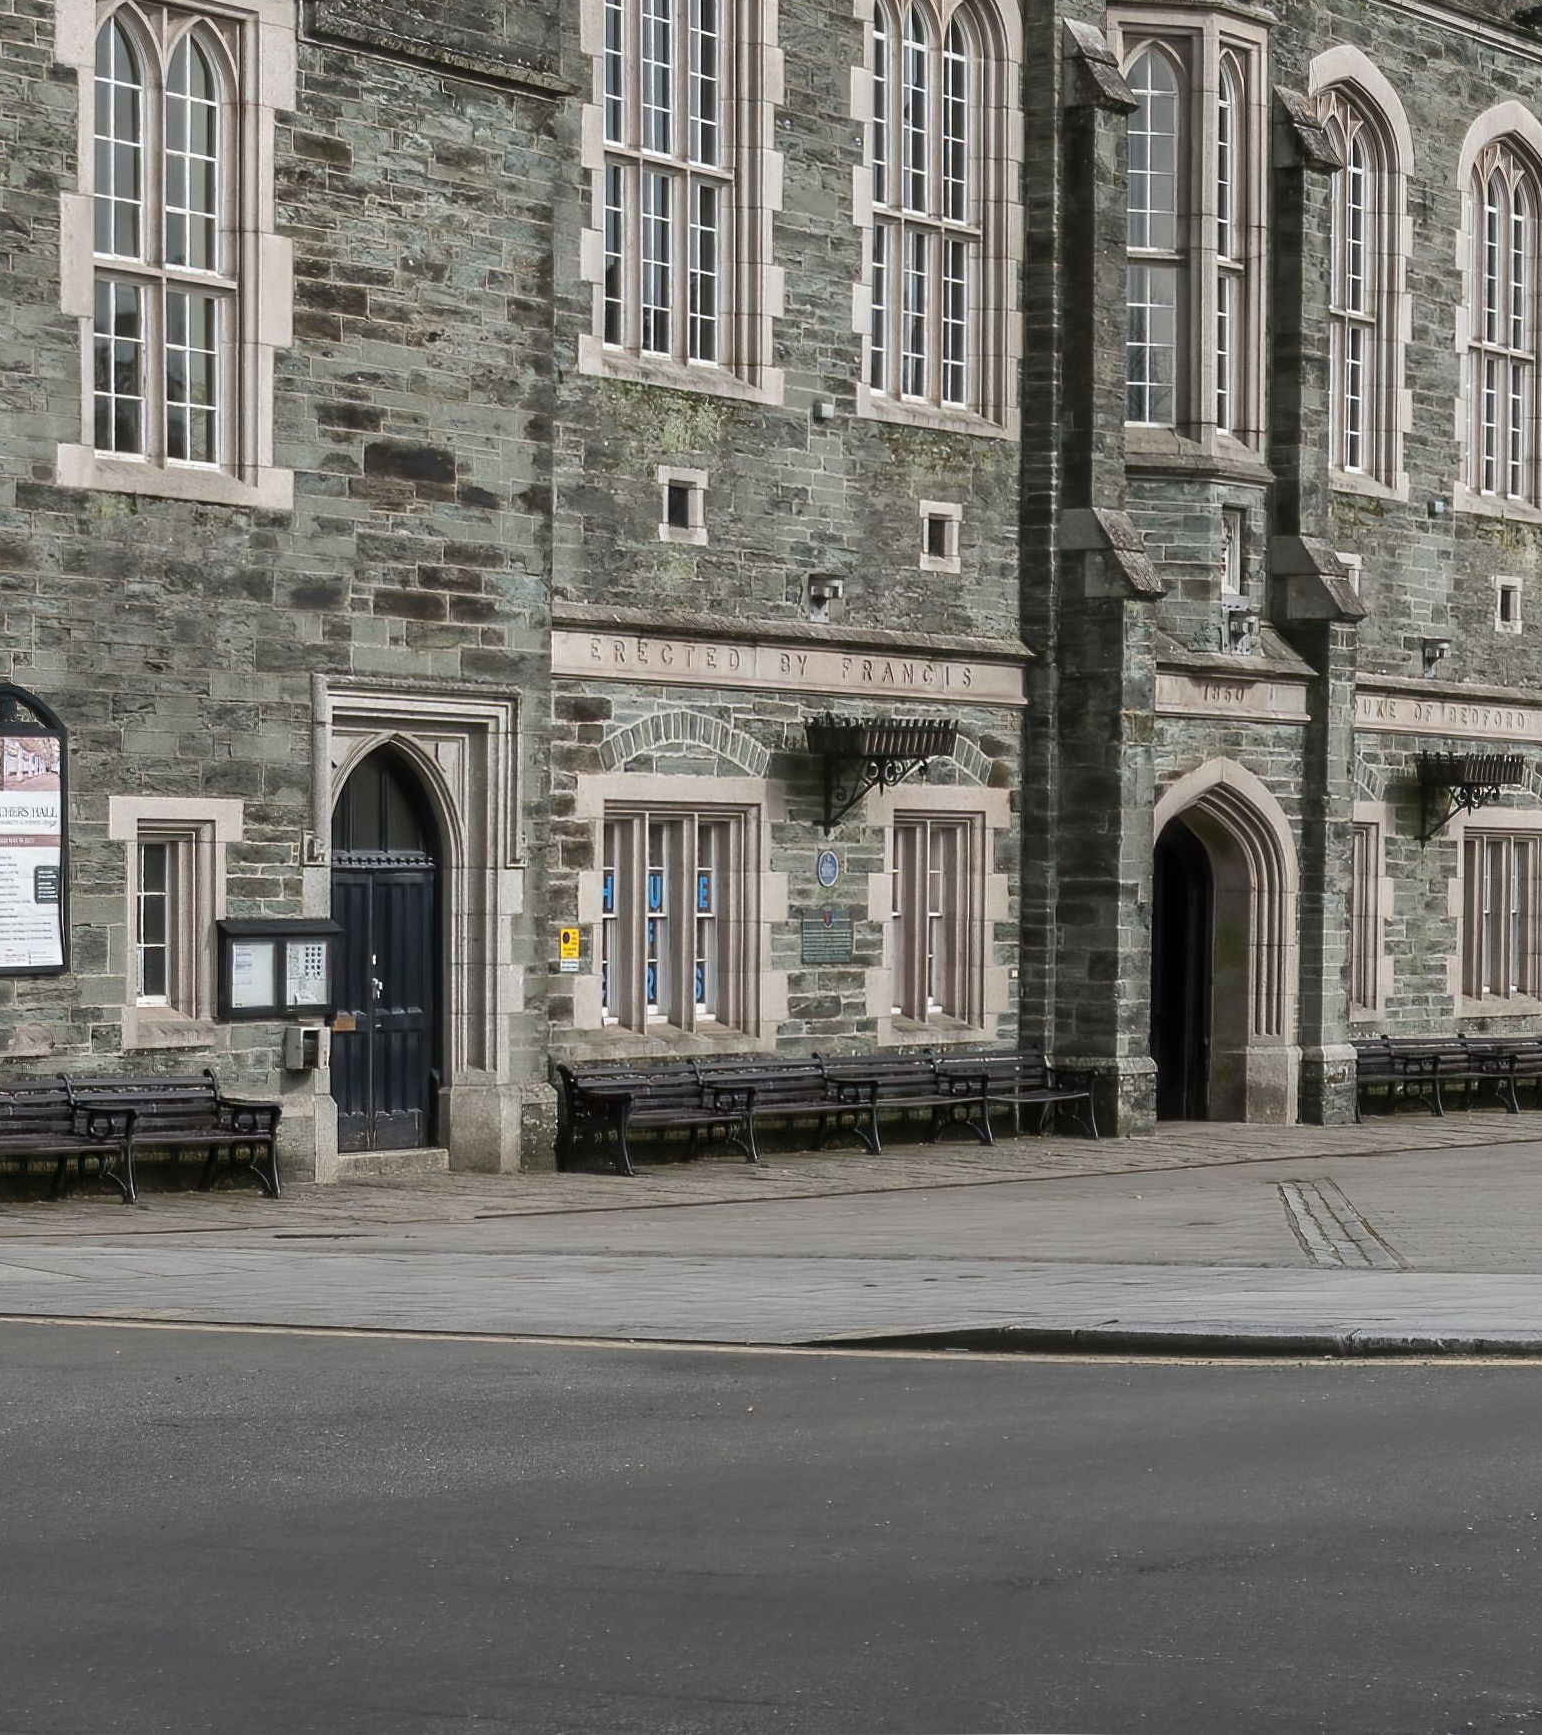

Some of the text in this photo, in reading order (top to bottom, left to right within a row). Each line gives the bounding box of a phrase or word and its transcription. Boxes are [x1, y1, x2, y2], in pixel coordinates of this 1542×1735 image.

[590, 637, 973, 688] ERECTED BY FRANCIS
[1413, 703, 1433, 722] OF
[1449, 706, 1525, 729] BEDFORD
[32, 807, 58, 818] HALL
